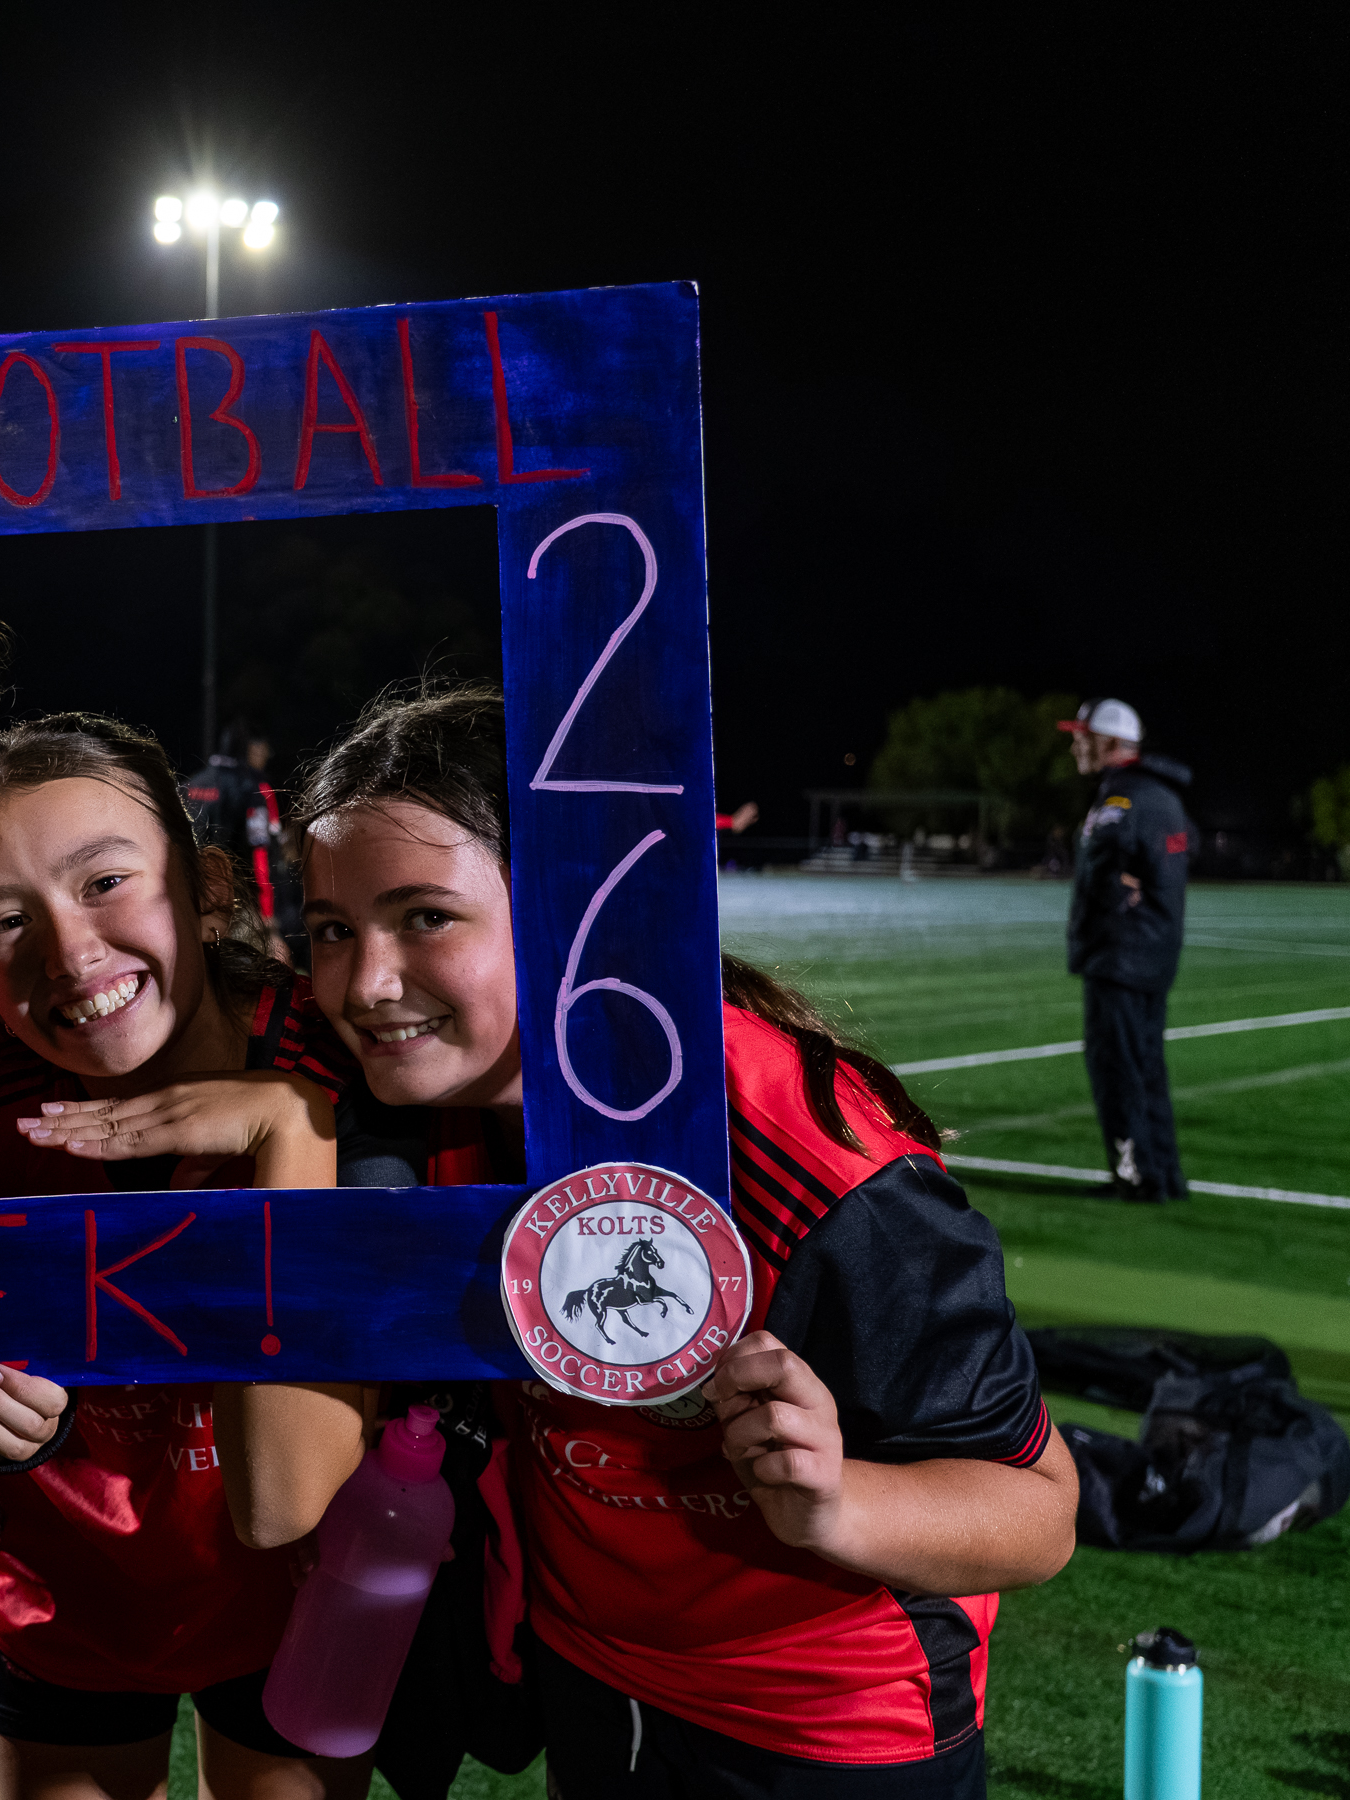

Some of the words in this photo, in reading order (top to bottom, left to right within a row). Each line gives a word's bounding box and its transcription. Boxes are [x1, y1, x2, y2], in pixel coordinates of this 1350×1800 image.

[524, 1172, 717, 1239] KELLYVILLE
[576, 1215, 666, 1236] KOLTS
[510, 1279, 533, 1294] 19
[718, 1276, 743, 1292] 77
[524, 1325, 646, 1393] SOCCER
[656, 1325, 730, 1387] CLUB
